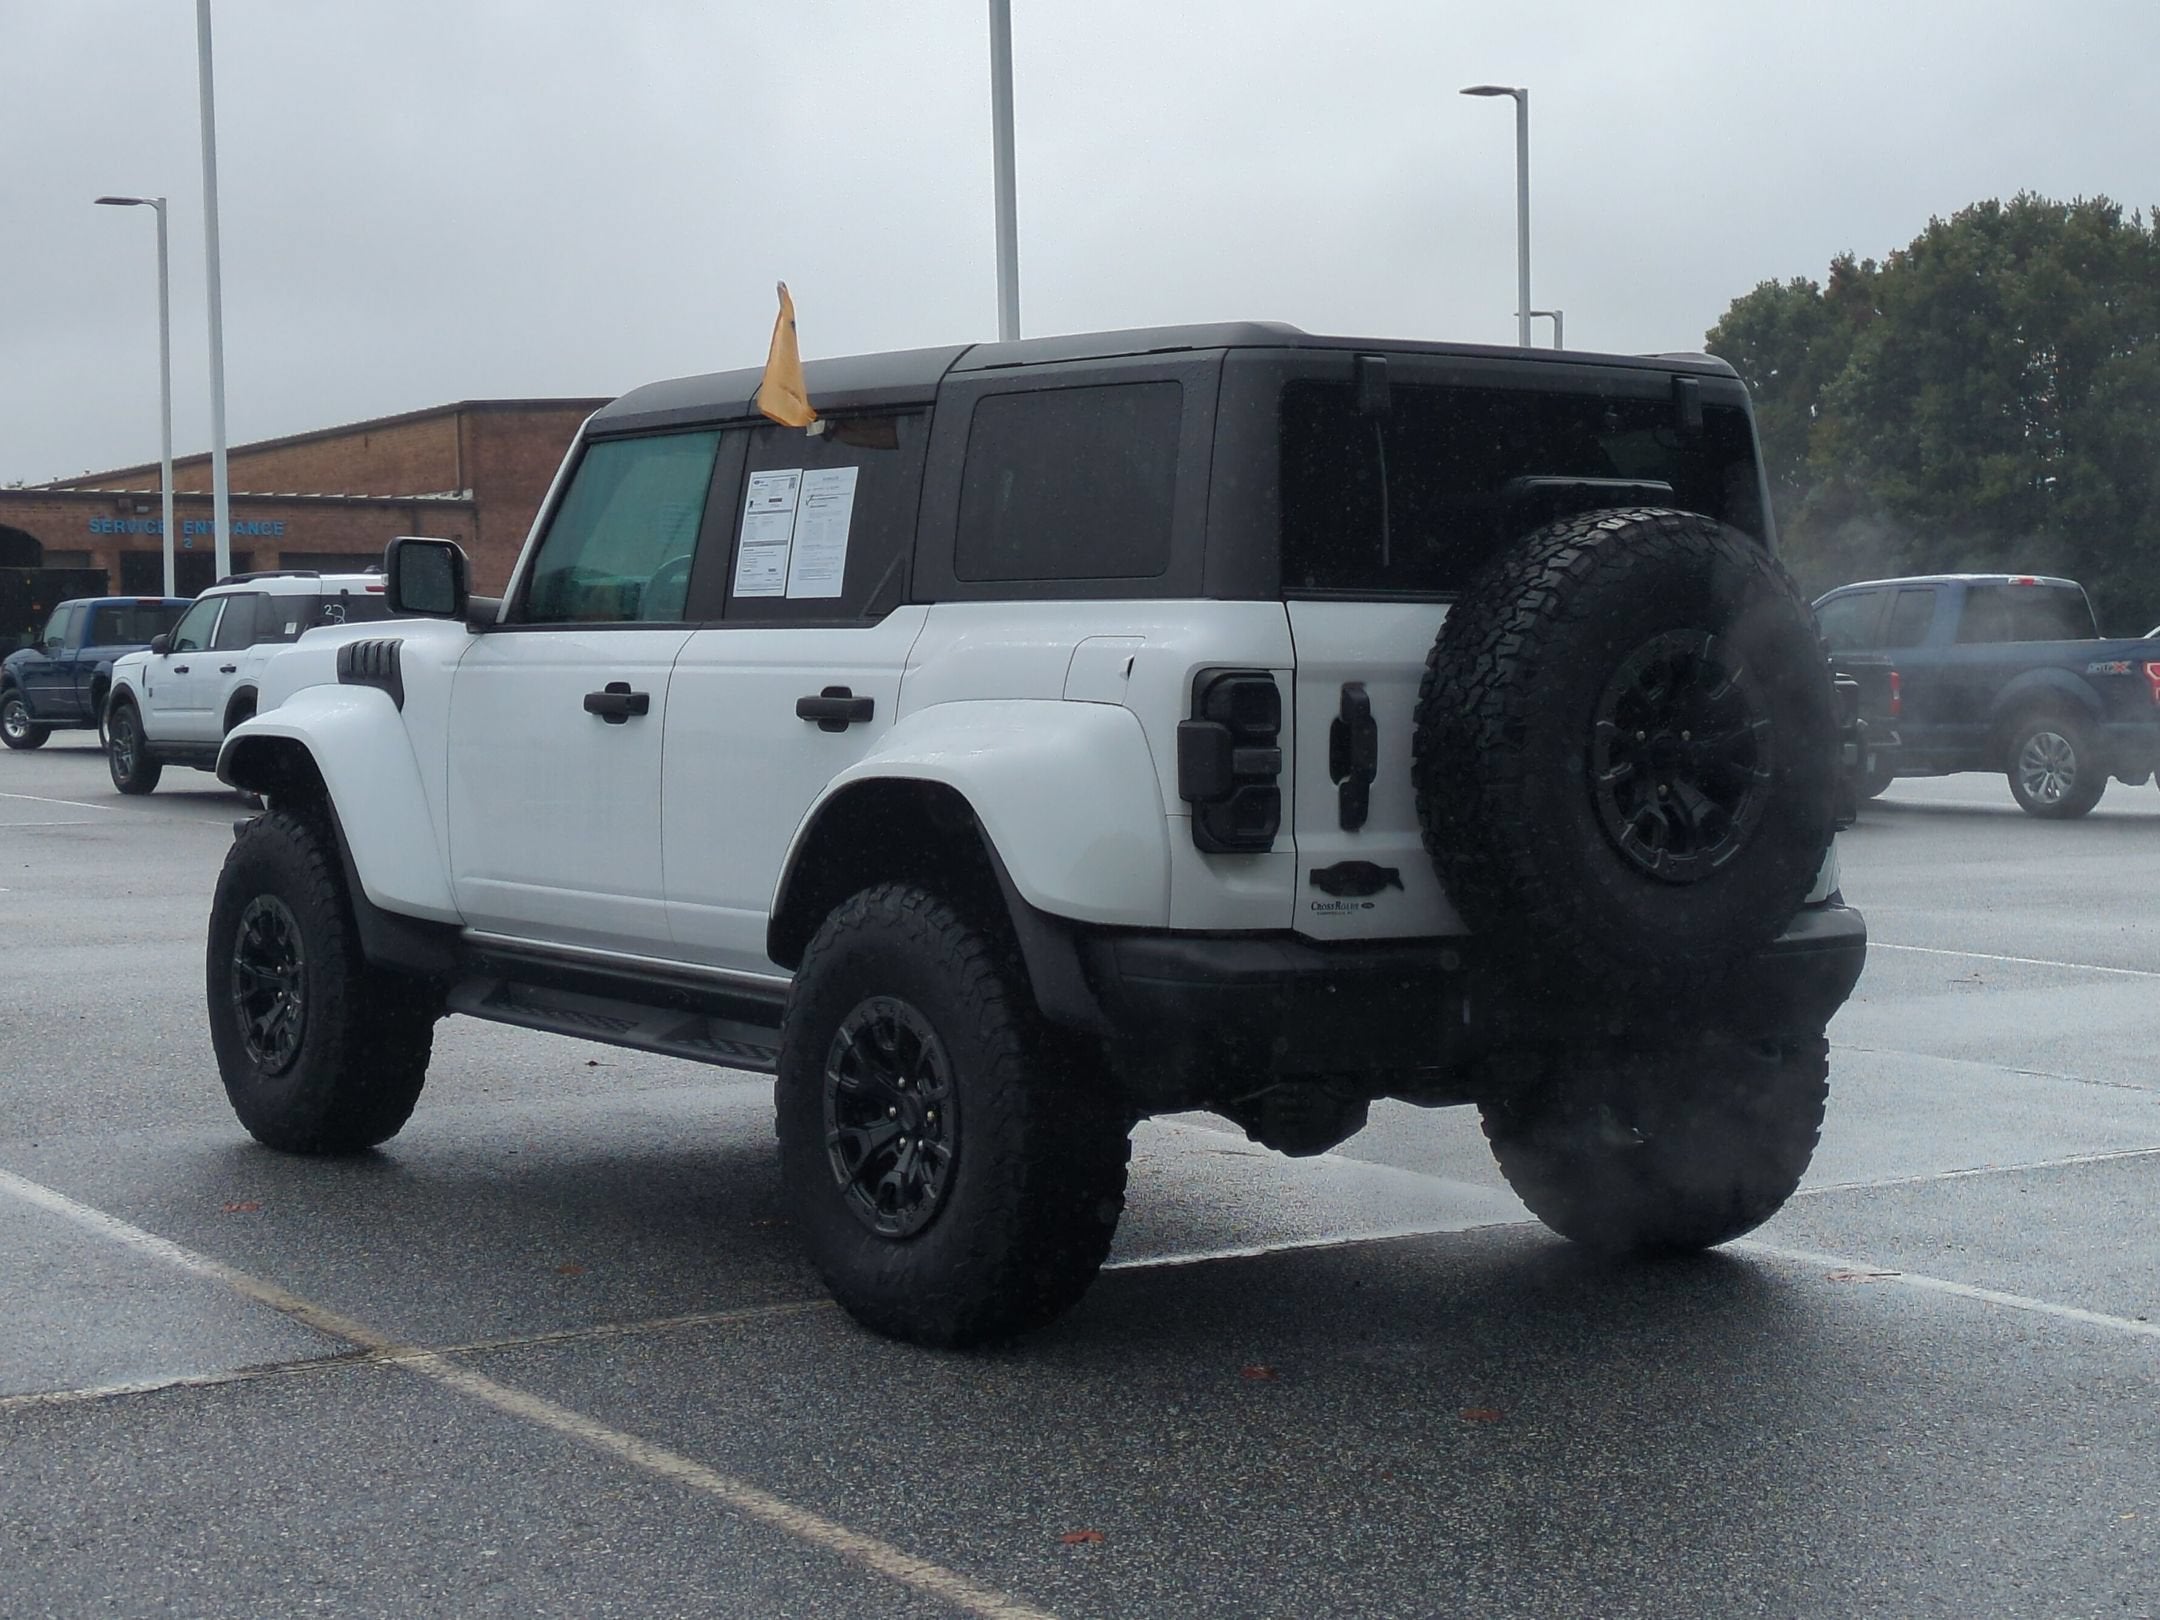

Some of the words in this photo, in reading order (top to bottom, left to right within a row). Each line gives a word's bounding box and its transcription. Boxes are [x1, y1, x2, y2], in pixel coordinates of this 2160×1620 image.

[89, 518, 164, 535] SERVICE
[183, 520, 285, 536] ENTANCE
[184, 538, 193, 549] 2
